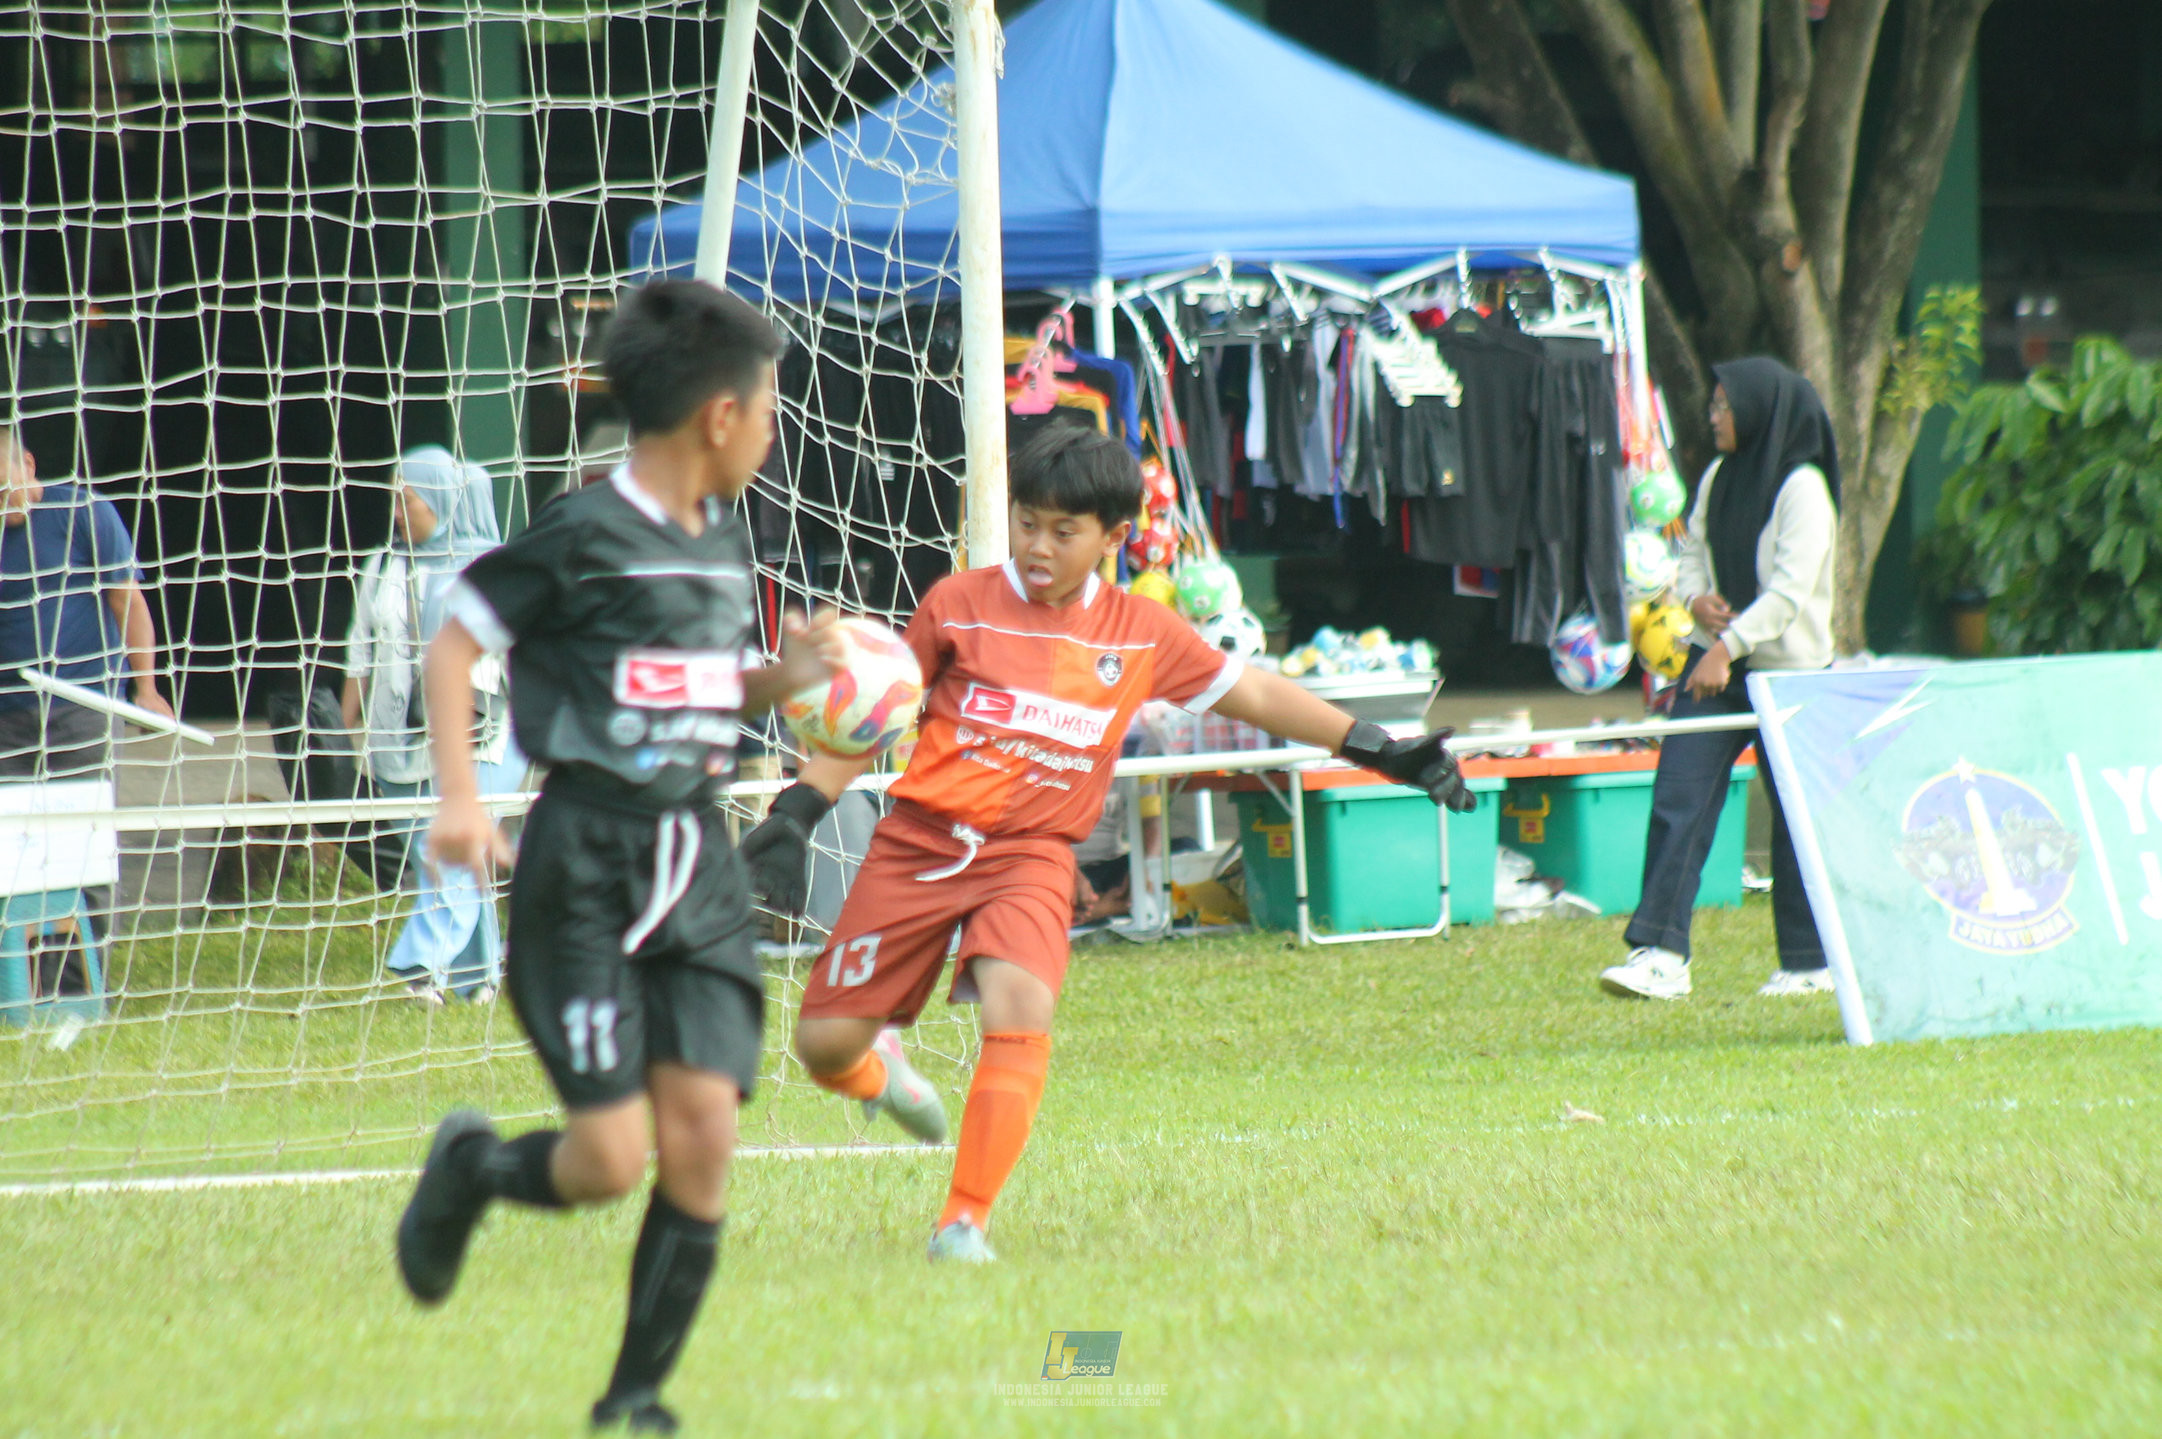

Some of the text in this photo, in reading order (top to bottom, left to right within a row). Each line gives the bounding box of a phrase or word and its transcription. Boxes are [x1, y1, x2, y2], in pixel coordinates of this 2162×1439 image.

[1022, 704, 1103, 740] DAIHATSU
[826, 935, 882, 987] 13
[562, 998, 618, 1074] 11
